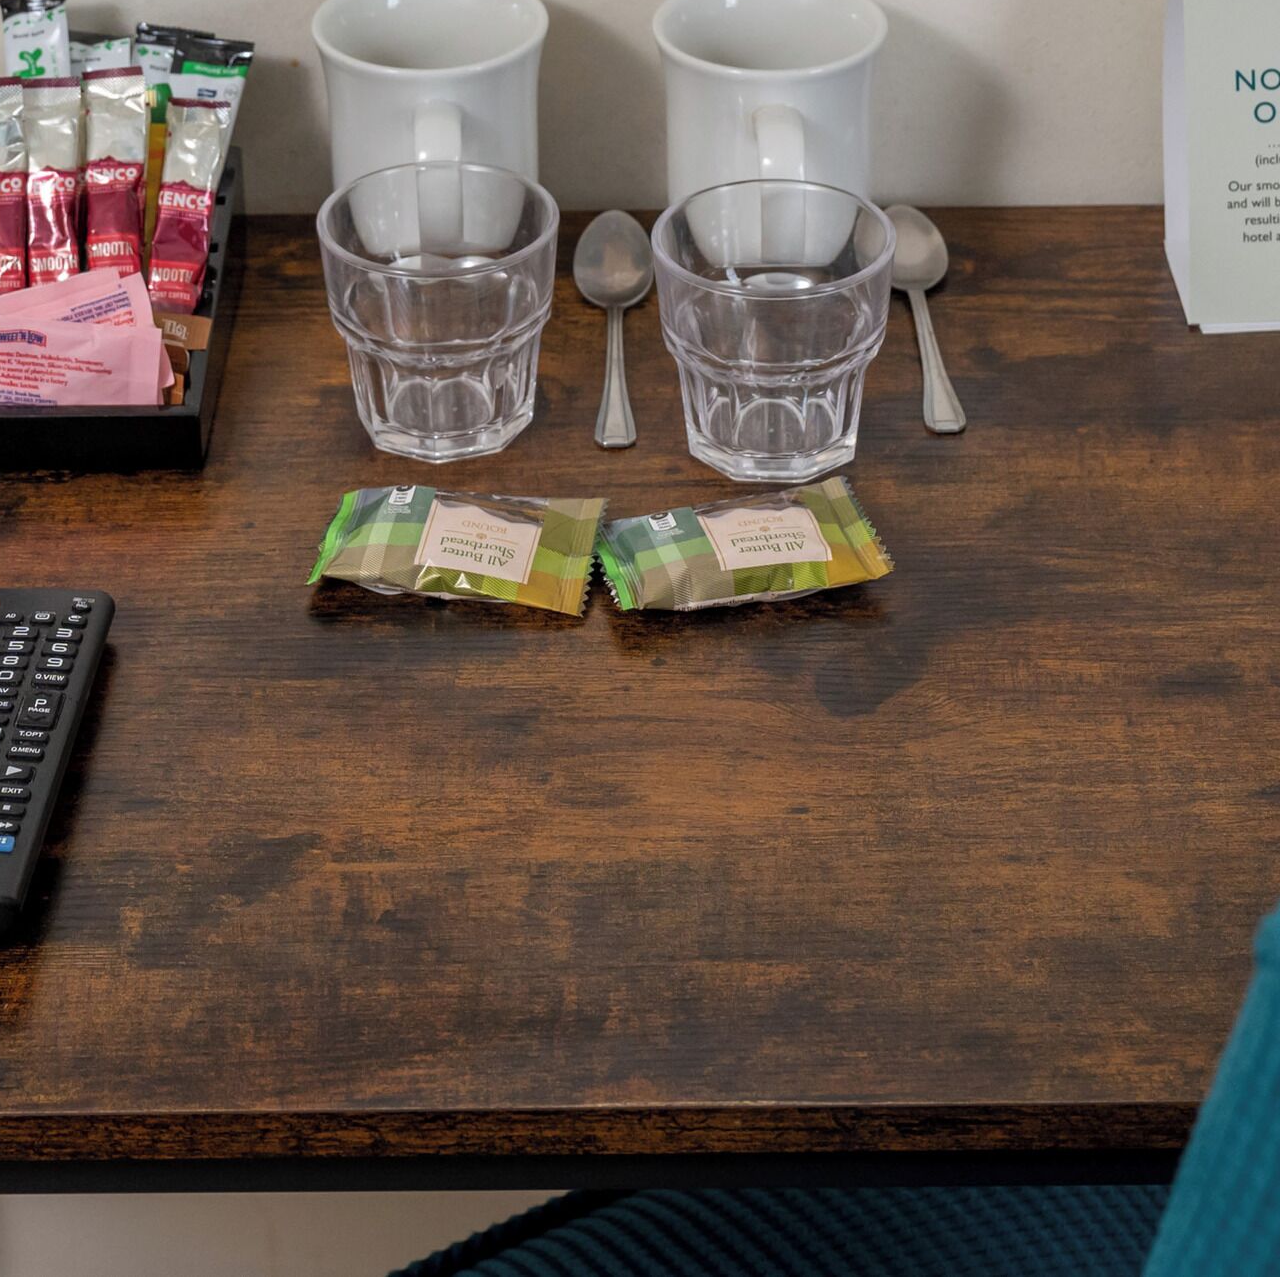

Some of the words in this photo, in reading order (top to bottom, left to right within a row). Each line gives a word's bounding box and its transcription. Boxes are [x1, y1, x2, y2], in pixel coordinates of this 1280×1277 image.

[1228, 180, 1252, 192] Our
[1227, 198, 1248, 209] and
[1252, 196, 1271, 208] will
[1243, 231, 1272, 242] hotel
[461, 520, 508, 535] ROUND
[730, 531, 806, 547] Shortbread
[440, 535, 516, 560] Shortbread
[739, 542, 782, 553] Butter
[785, 540, 805, 552] All
[441, 547, 483, 562] Butter
[489, 556, 508, 567] All
[12, 626, 30, 636] 2
[56, 628, 73, 638] 3
[8, 641, 25, 651] 5
[51, 643, 68, 653] 6
[2, 655, 19, 665] 8
[46, 657, 63, 667] 9
[35, 673, 65, 682] Q.VIEW
[34, 698, 47, 707] P
[19, 730, 44, 738] T.OPT
